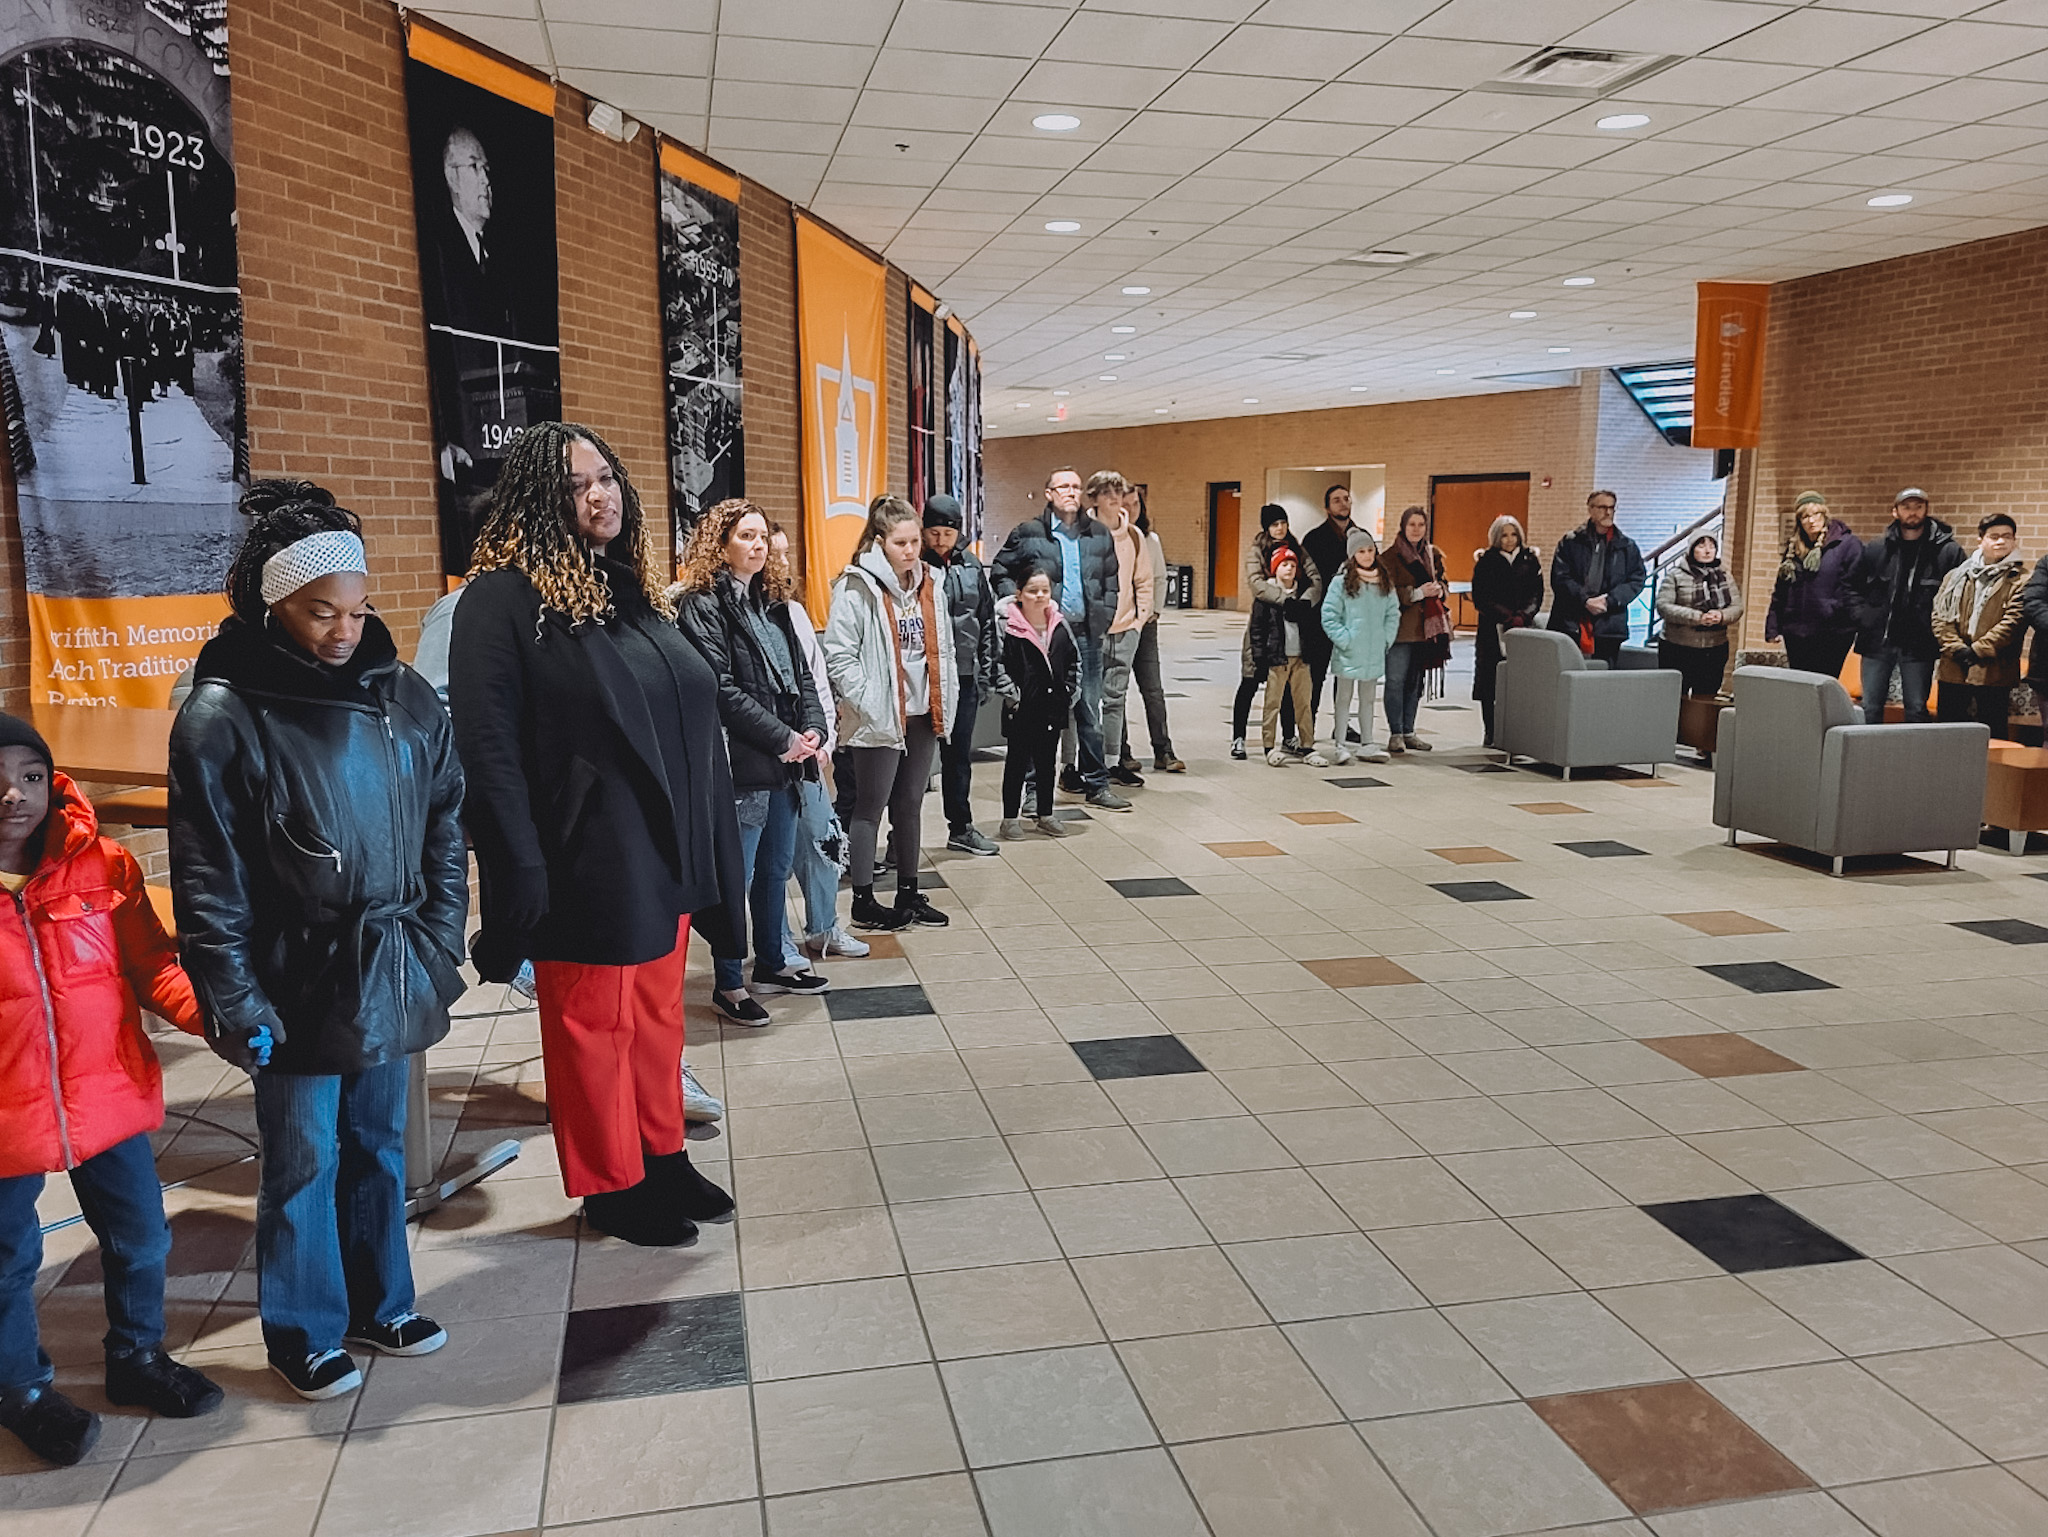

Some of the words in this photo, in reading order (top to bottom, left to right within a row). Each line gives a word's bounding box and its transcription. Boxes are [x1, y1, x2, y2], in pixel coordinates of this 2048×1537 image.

[128, 121, 204, 170] 1923
[694, 257, 733, 288] 1955-70
[1714, 352, 1736, 417] Findlay
[50, 626, 120, 649] riffith
